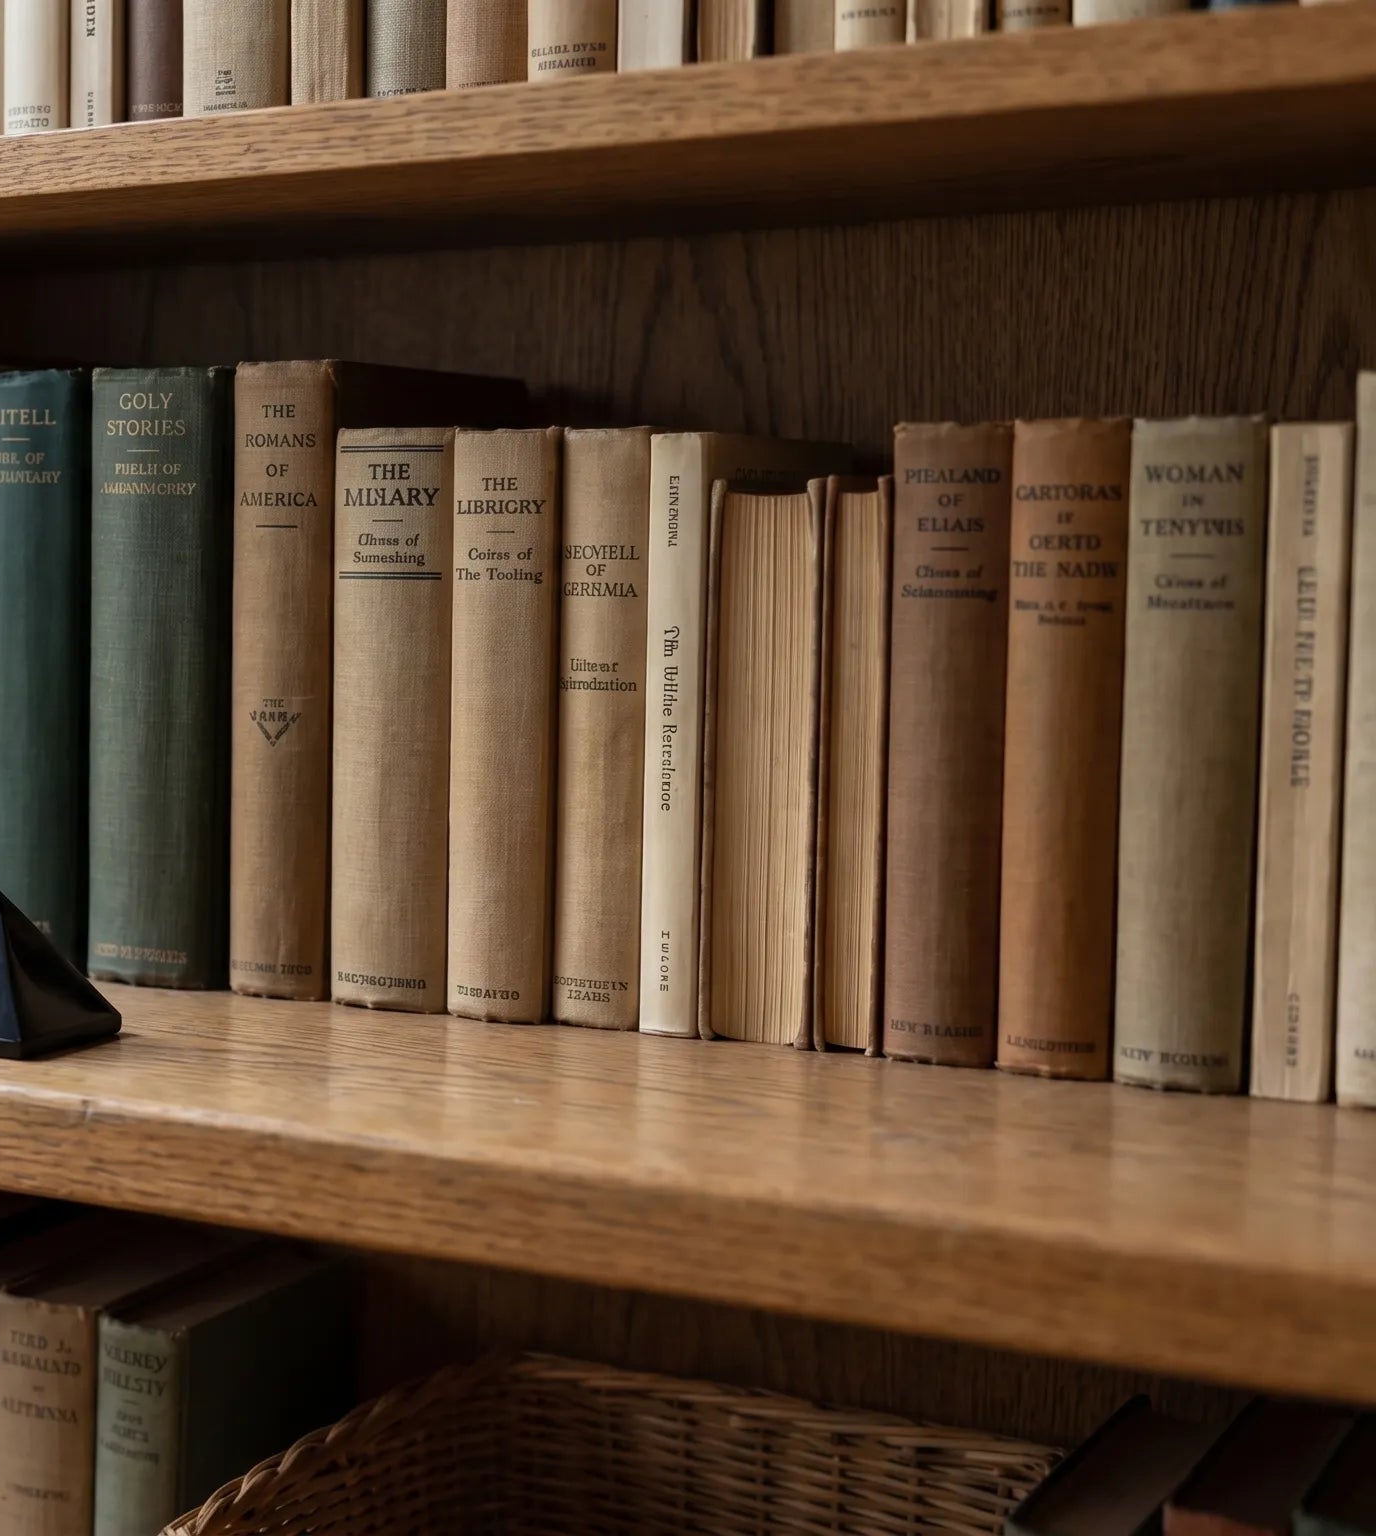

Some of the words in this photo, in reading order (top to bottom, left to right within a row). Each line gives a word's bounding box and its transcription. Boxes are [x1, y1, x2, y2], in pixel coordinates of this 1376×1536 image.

[119, 393, 175, 410] GOLY
[262, 404, 296, 418] THE
[106, 420, 186, 436] STORIES
[245, 434, 316, 448] ROMANS
[163, 463, 181, 475] OF
[266, 464, 289, 477] OF
[368, 464, 411, 480] THE
[1145, 464, 1245, 483] WOMAN
[482, 477, 518, 491] THE
[240, 492, 318, 507] AMERICA
[938, 494, 964, 507] OF
[405, 533, 420, 546] of
[353, 551, 425, 567] Sumeshing
[517, 548, 533, 561] of
[456, 568, 481, 581] The
[486, 568, 543, 584] Tooling
[586, 564, 606, 576] OF
